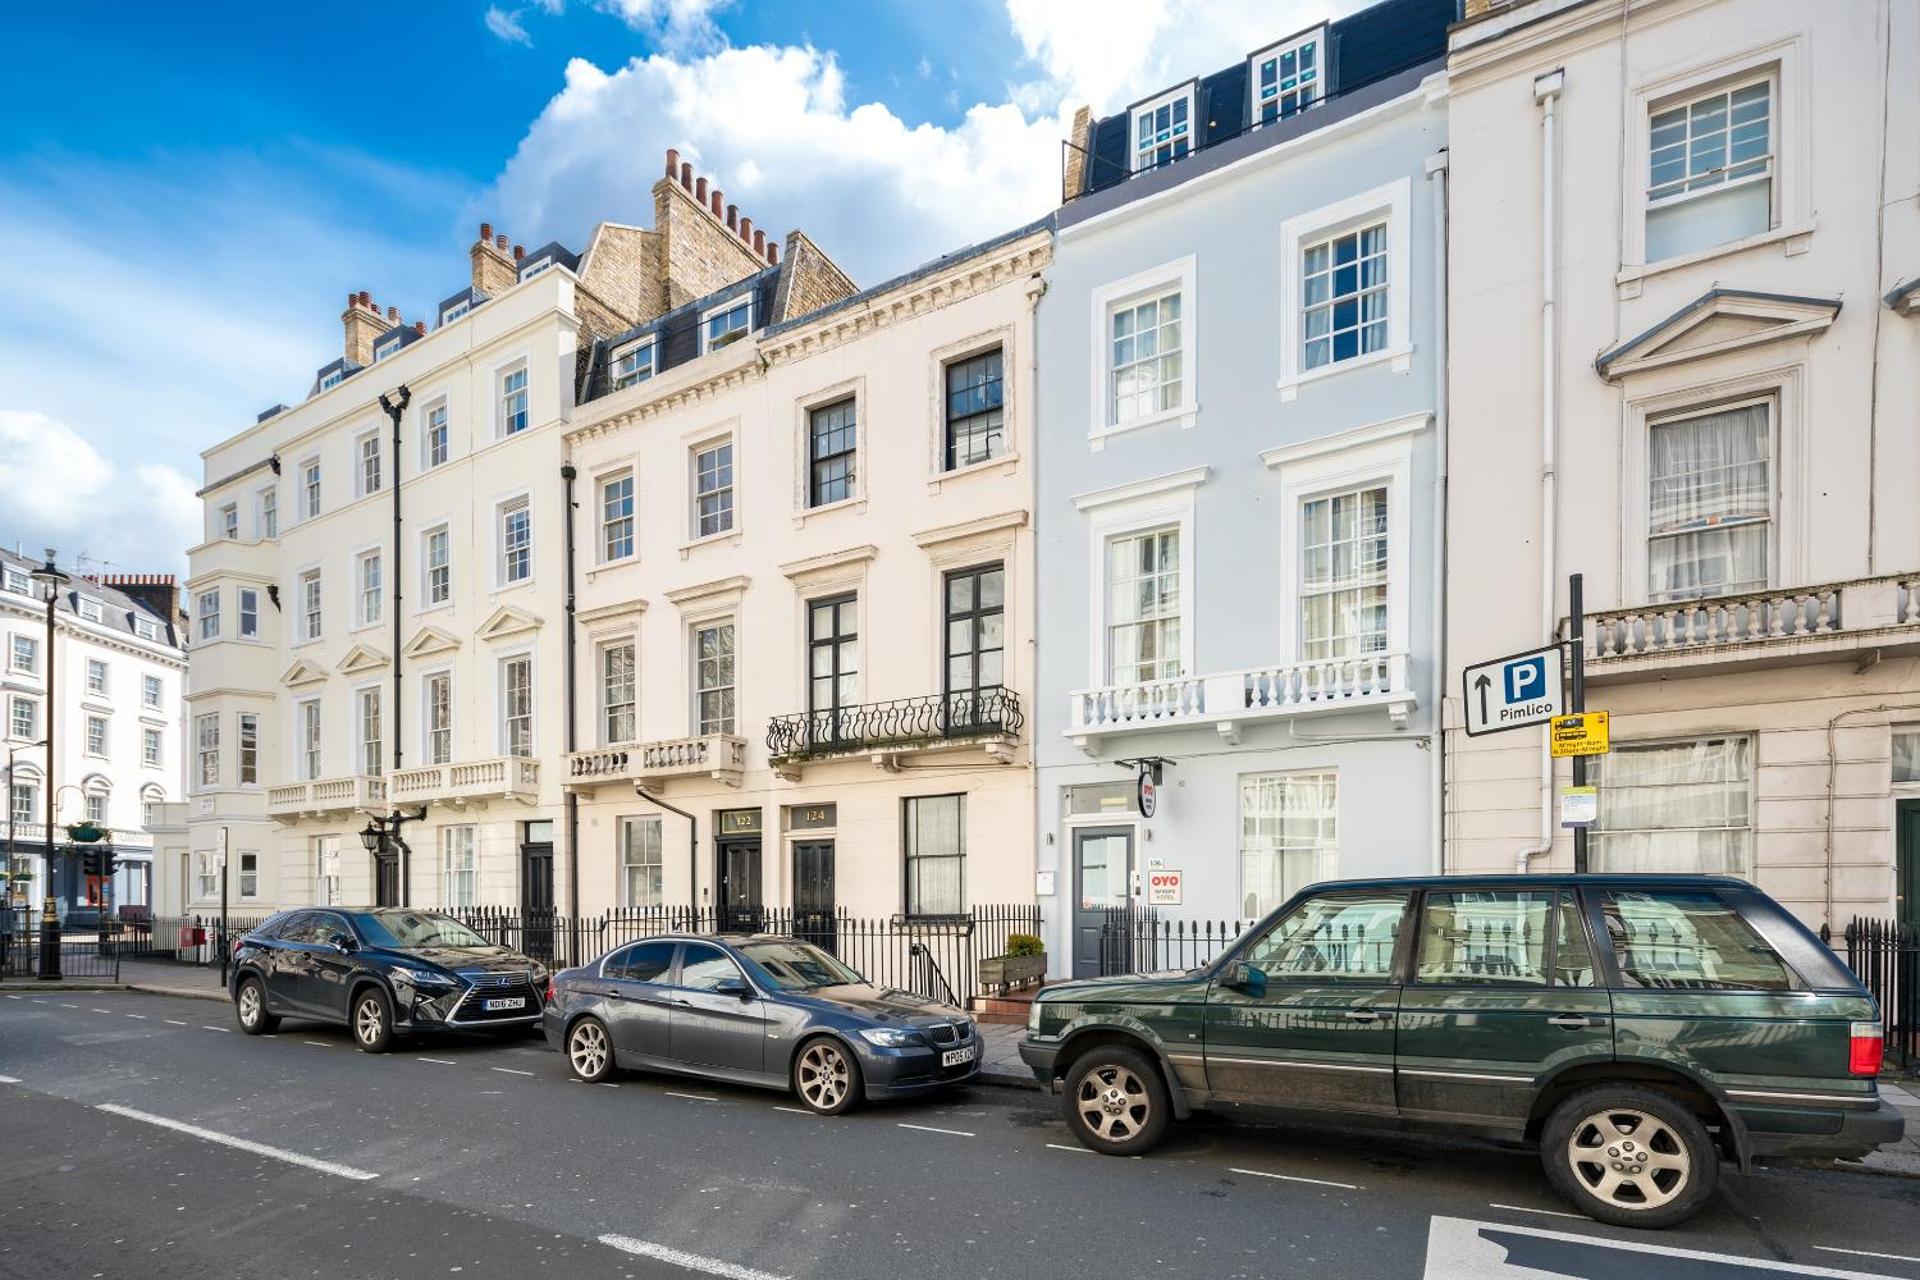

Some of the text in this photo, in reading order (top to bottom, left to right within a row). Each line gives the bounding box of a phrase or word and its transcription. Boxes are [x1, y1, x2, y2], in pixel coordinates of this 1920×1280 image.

[1512, 663, 1538, 700] P
[1500, 703, 1553, 721] Pimlico
[736, 815, 752, 826] 122
[806, 809, 826, 822] 124
[1151, 876, 1179, 887] OYO
